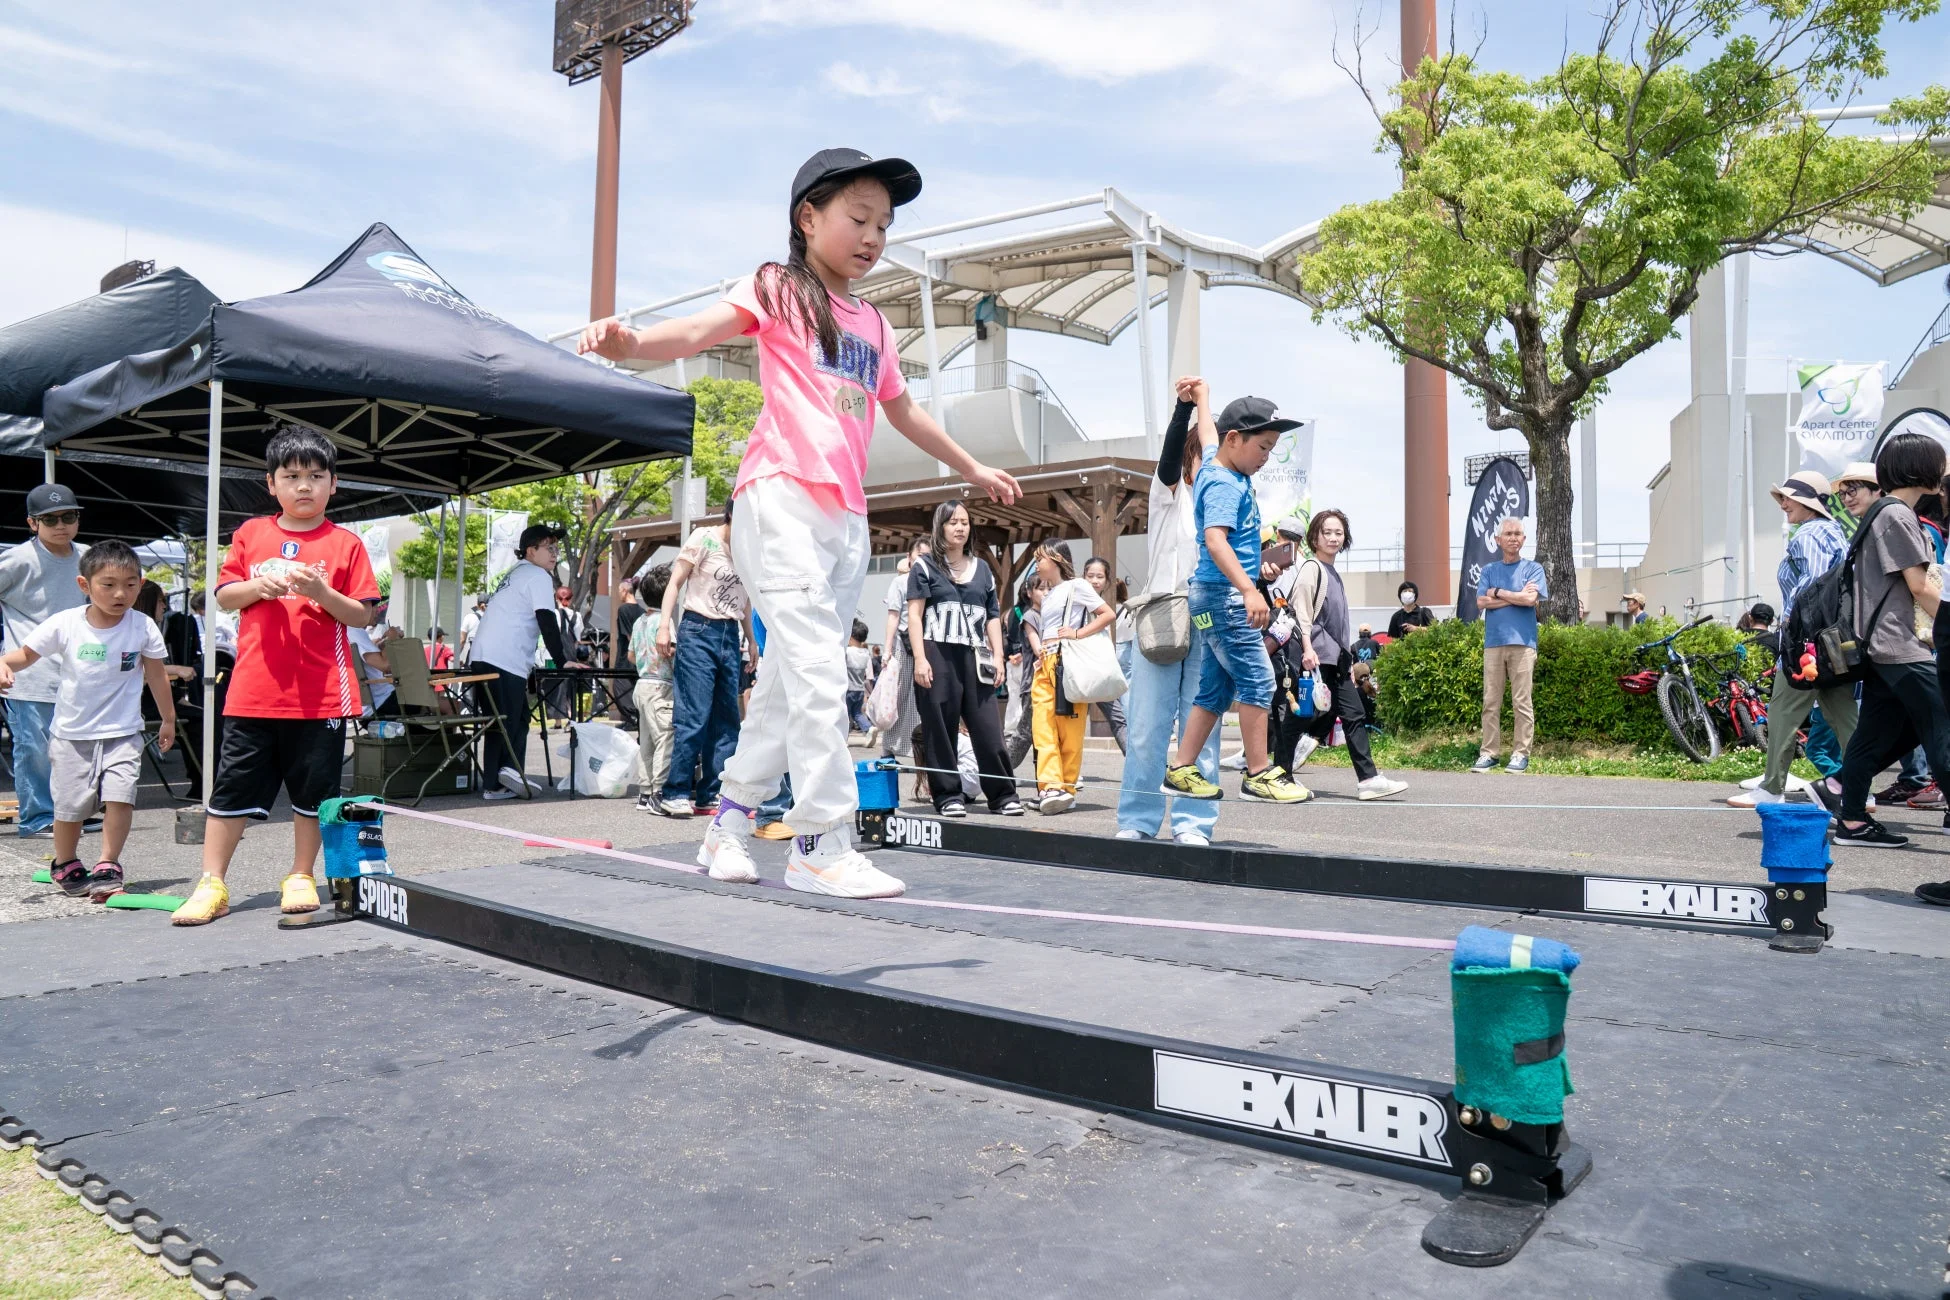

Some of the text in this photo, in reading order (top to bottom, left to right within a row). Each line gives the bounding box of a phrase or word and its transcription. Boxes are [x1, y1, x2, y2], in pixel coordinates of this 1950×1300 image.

[1801, 420, 1877, 431] Apart Center
[1801, 430, 1875, 441] OKAMOTO
[1471, 471, 1508, 538] NINJA
[923, 601, 987, 647] NIK
[885, 817, 942, 848] SPIDER
[359, 876, 409, 926] SPIDER
